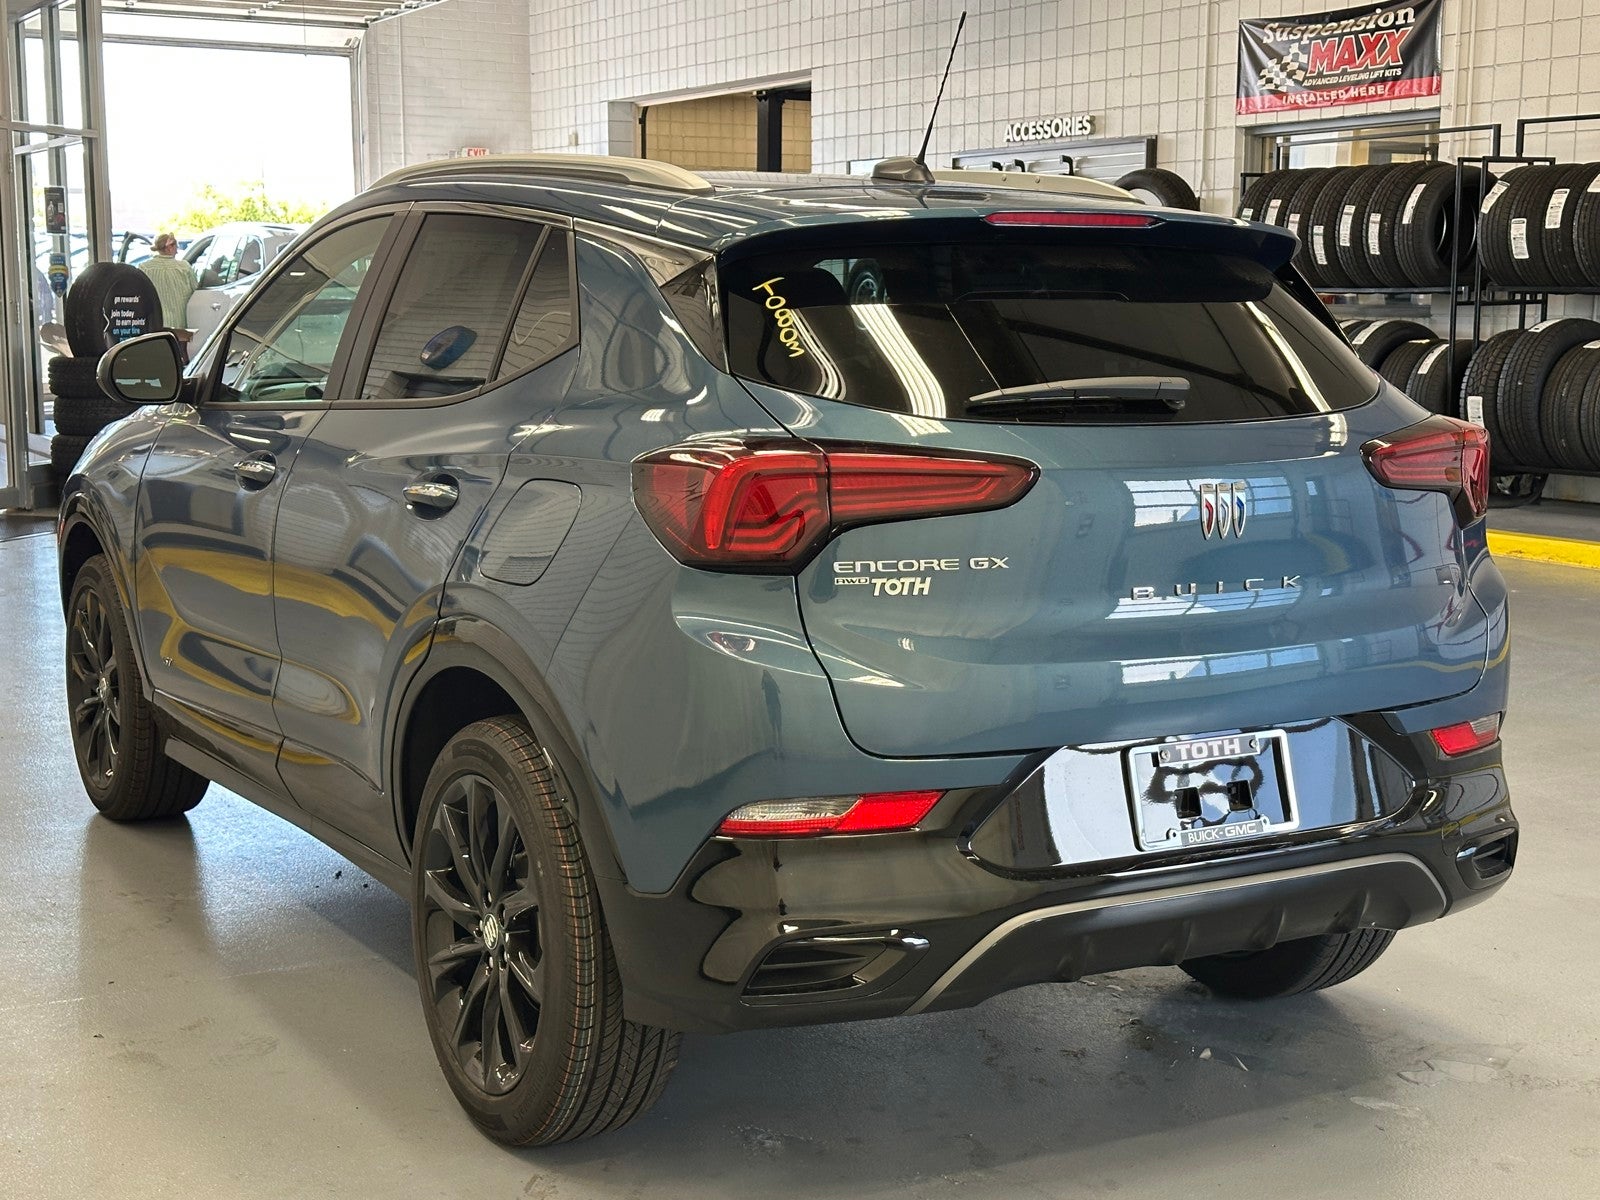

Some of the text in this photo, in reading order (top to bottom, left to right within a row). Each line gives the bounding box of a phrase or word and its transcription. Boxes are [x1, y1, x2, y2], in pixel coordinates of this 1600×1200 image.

[1262, 7, 1416, 44] Suspension
[1306, 26, 1414, 77] MAXX
[1302, 67, 1402, 87] ADVANCED LEVELING LIFT KITS
[1282, 85, 1385, 105] INSTALLED HERE
[1003, 115, 1091, 142] ACCESSORIES
[467, 148, 487, 157] EXIT
[111, 309, 135, 319] join today
[120, 328, 131, 336] your
[131, 327, 141, 335] tire
[833, 556, 1010, 573] ENCORE GX
[835, 577, 869, 585] AWD
[871, 576, 932, 597] TOTH
[1131, 575, 1301, 601] BUICK
[1175, 737, 1242, 761] TOTH
